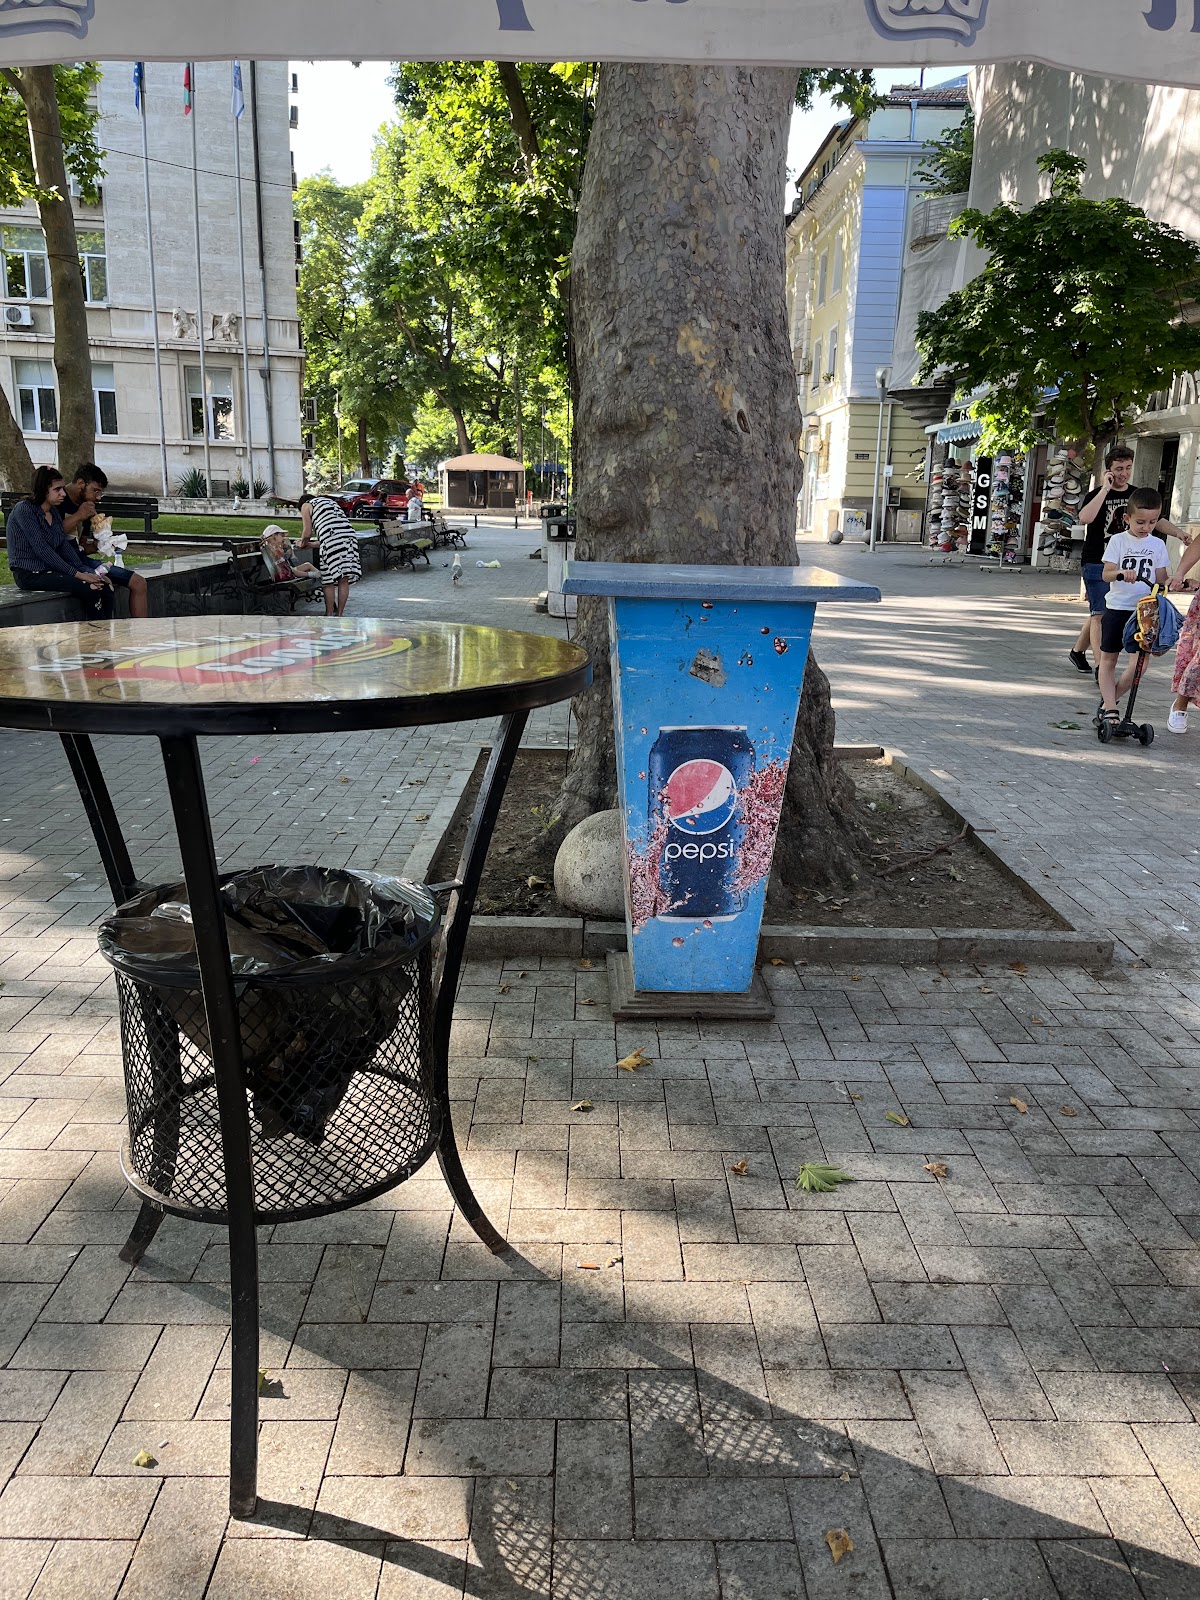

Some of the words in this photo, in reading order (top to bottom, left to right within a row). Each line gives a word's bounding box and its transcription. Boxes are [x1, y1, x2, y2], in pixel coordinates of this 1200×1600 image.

[973, 473, 990, 530] GSM
[195, 633, 368, 675] foods
[664, 838, 734, 864] pepsi
